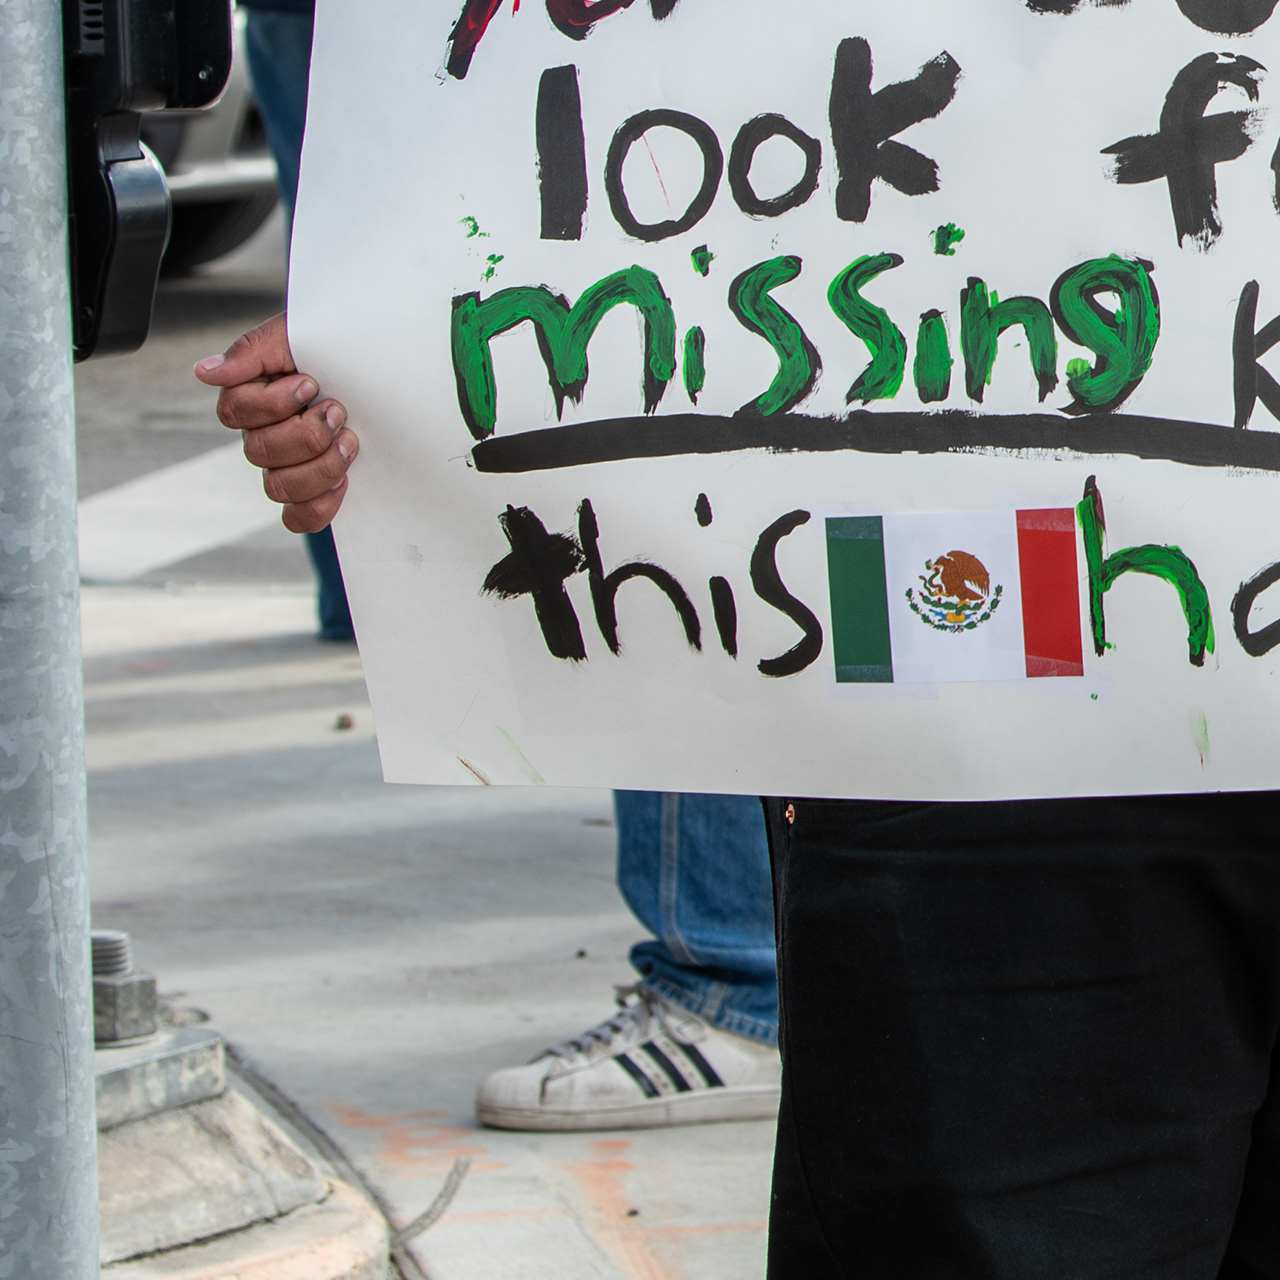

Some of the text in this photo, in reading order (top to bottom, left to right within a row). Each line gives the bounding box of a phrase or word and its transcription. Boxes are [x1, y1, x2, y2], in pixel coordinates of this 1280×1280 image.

[537, 35, 962, 241] look
[450, 223, 1160, 438] missing
[483, 495, 825, 678] this
